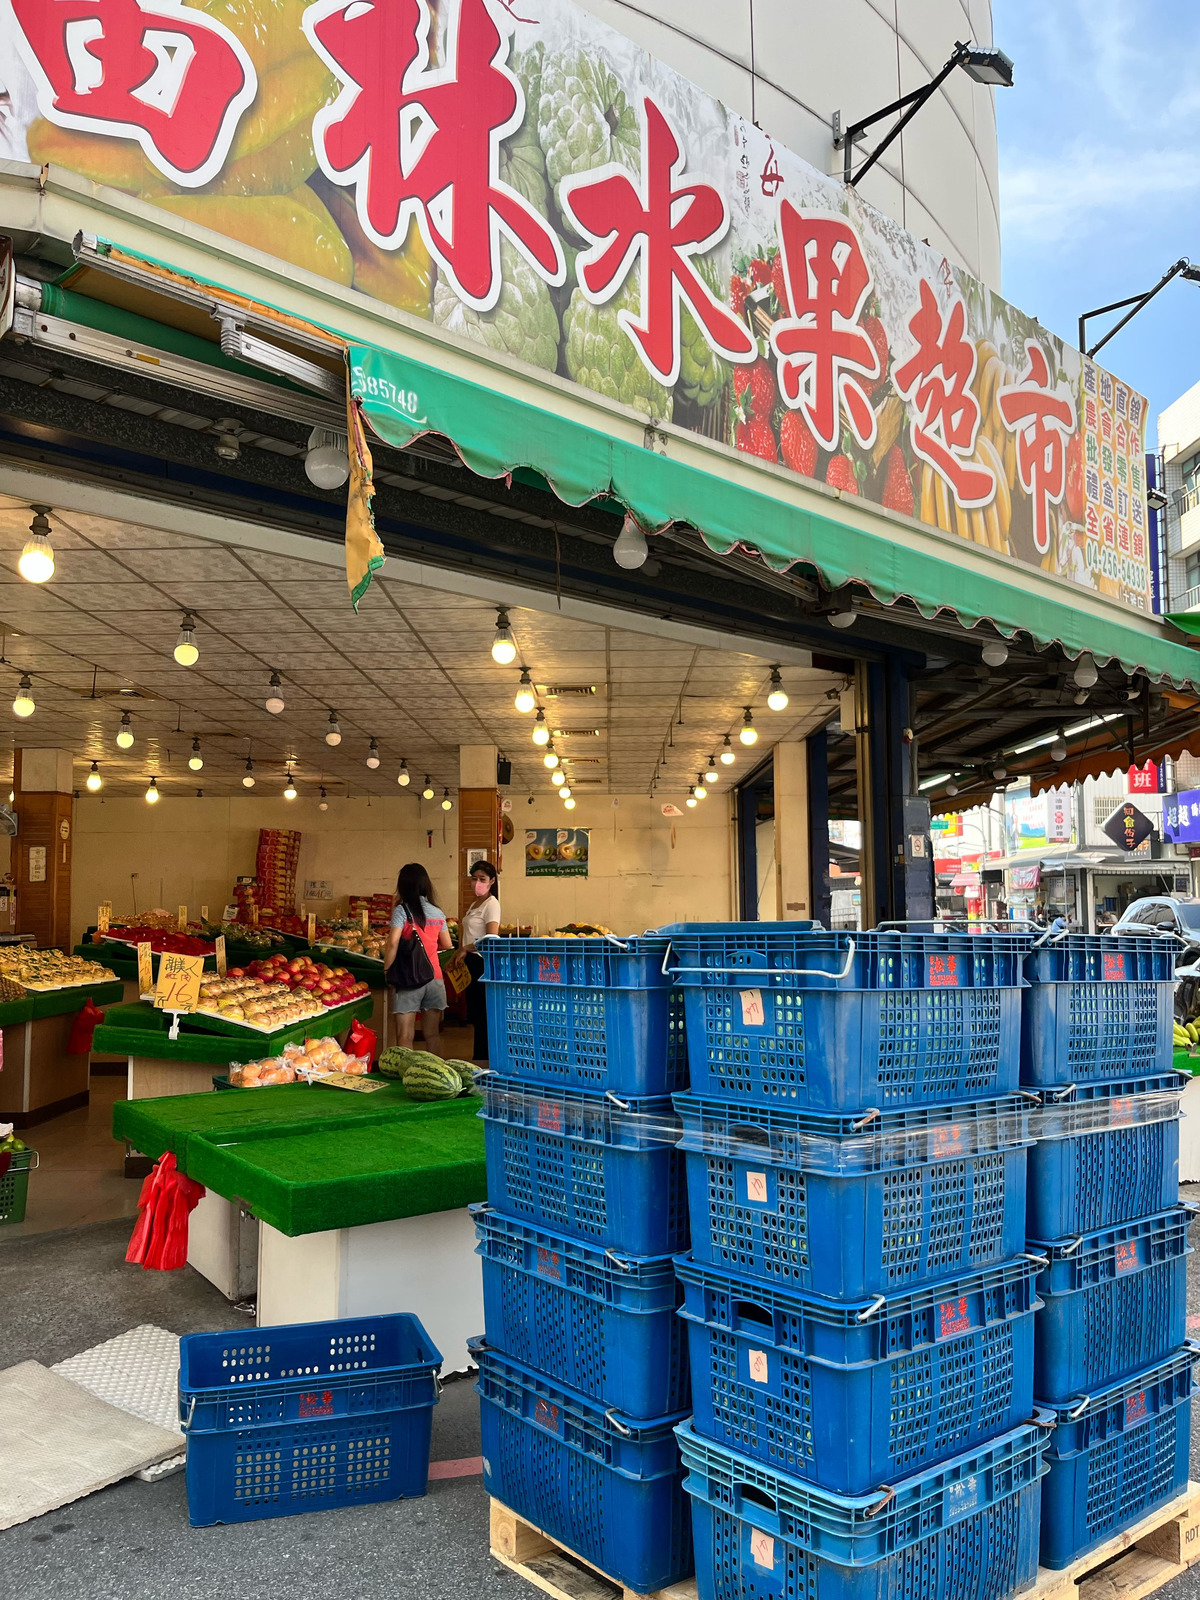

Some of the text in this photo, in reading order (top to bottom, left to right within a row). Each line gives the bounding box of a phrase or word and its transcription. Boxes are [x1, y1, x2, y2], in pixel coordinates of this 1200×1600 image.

[1084, 363, 1141, 425] 產地直銷
[1086, 399, 1140, 457] 農會合作
[1086, 434, 1141, 491] 批發零售
[1086, 469, 1142, 526] 禮盒訂送
[1087, 506, 1144, 558] 全省連鎖
[1086, 542, 1146, 591] 04-256-54338
[166, 982, 193, 1003] 16
[1185, 1525, 1200, 1545] RDT
